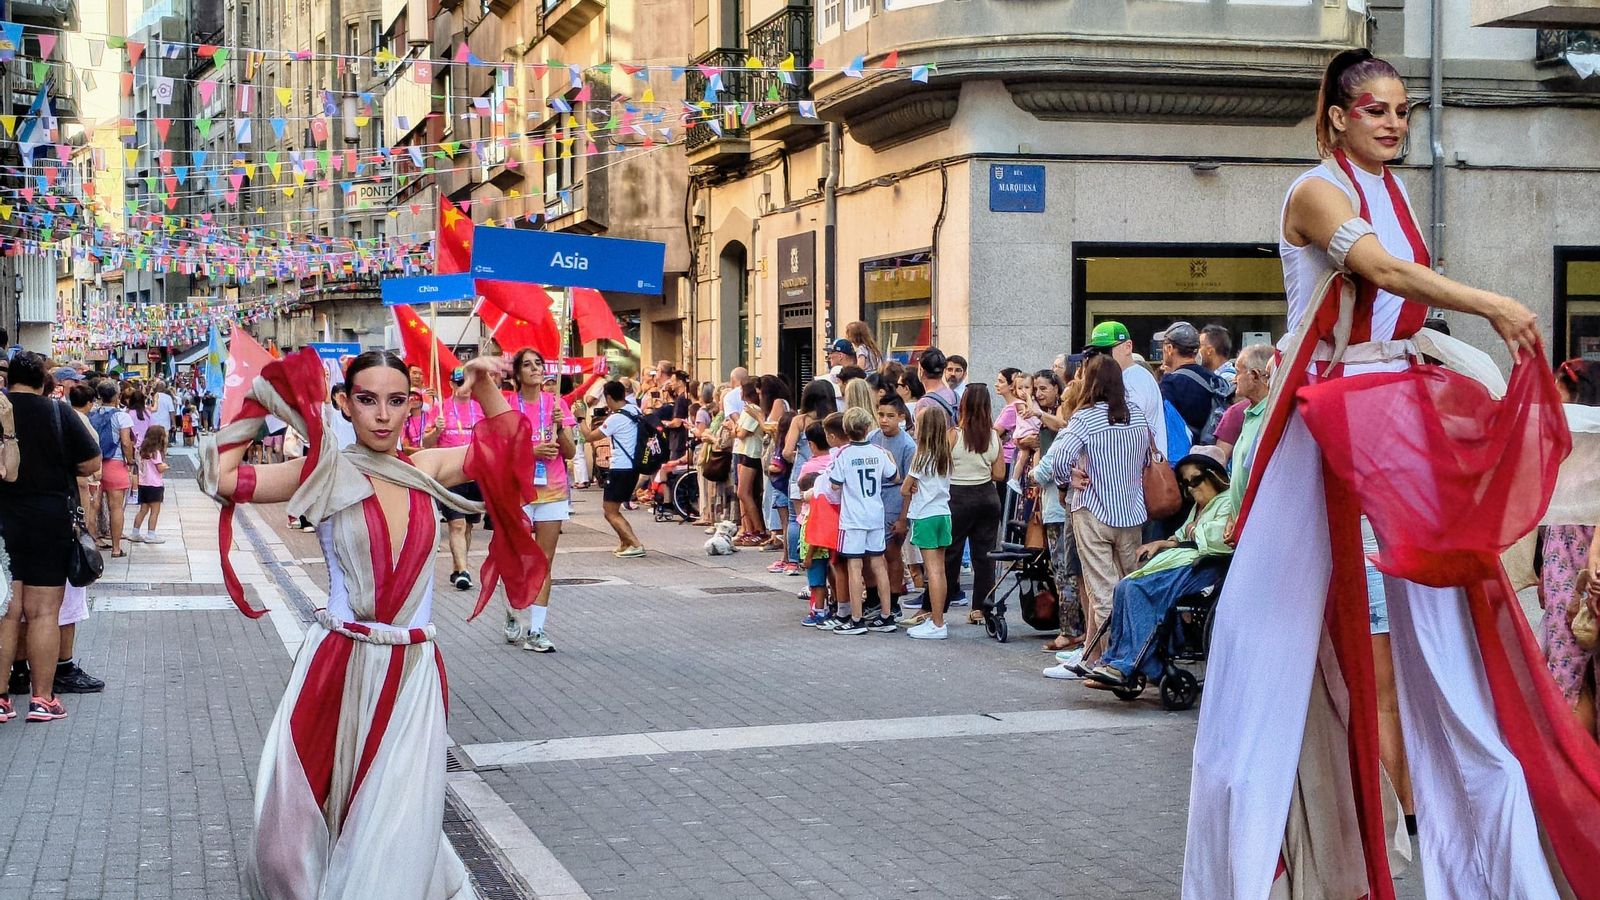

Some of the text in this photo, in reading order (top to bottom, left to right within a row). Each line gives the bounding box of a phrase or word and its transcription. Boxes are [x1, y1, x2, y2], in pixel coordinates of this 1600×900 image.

[999, 183, 1037, 193] MARQUESA
[550, 251, 589, 270] Asia
[418, 285, 439, 293] China
[857, 468, 876, 498] 15
